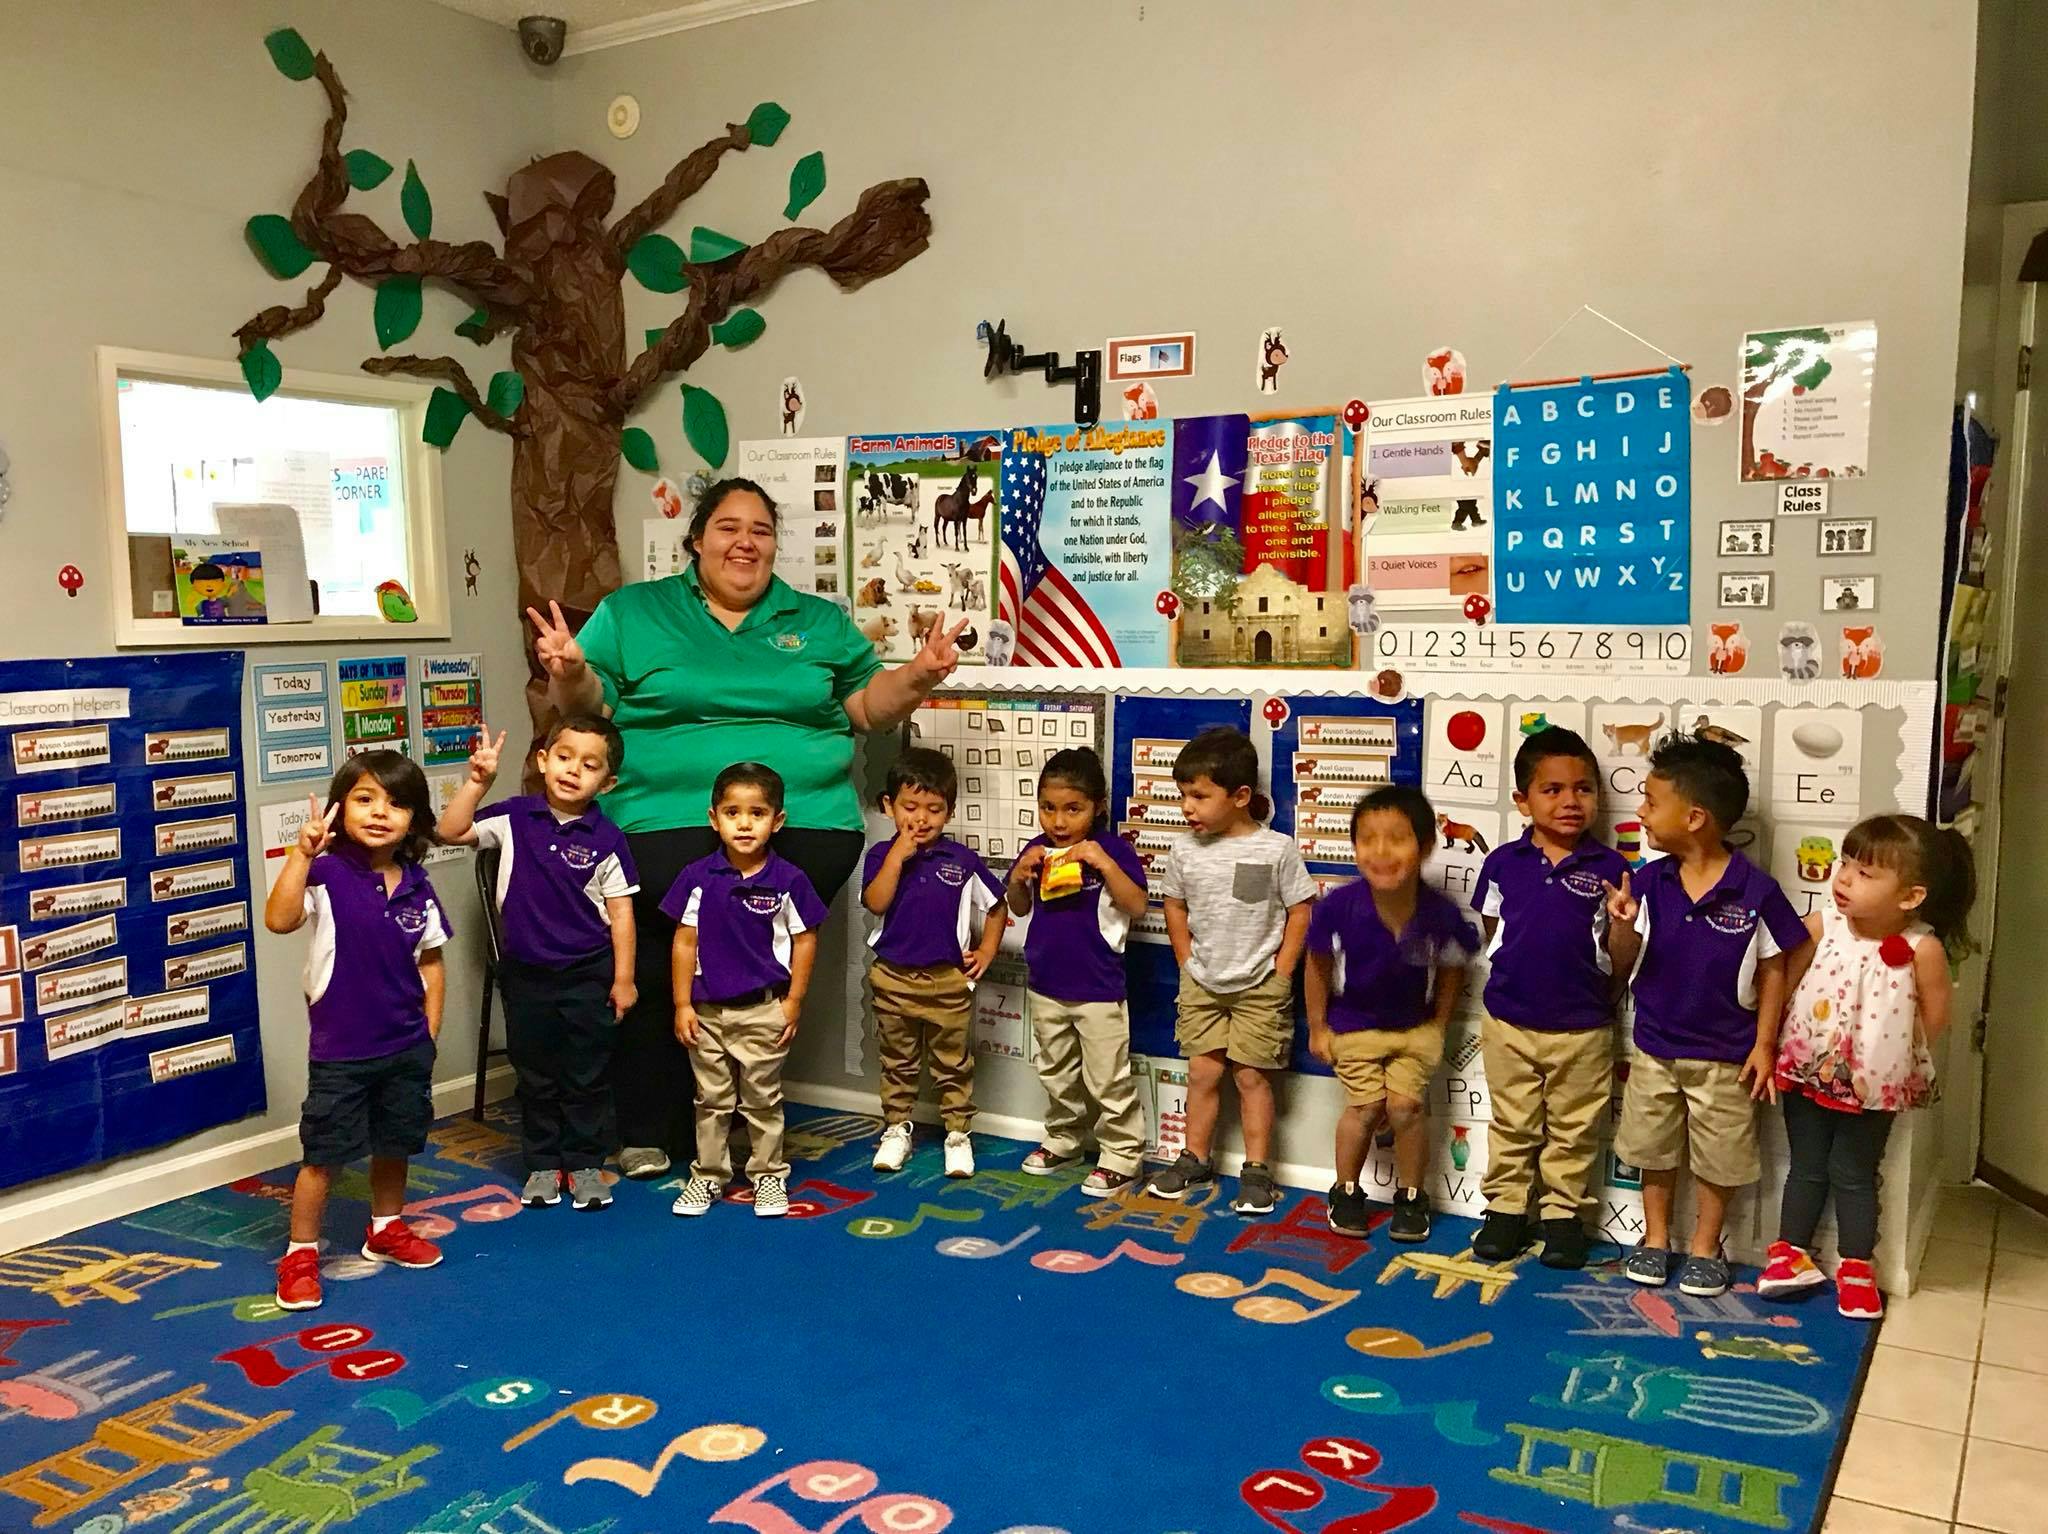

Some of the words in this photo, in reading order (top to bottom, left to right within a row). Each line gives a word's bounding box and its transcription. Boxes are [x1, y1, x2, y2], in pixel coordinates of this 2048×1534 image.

[1120, 353, 1141, 363] Flags
[1503, 405, 1521, 426] A
[1542, 400, 1558, 422] B
[1577, 395, 1594, 417] C
[1616, 392, 1635, 413] D
[1658, 388, 1672, 409] E
[1372, 415, 1393, 428] Our
[1395, 410, 1457, 427] Classroom
[1460, 407, 1491, 422] Rules
[850, 438, 892, 454] Farm
[895, 435, 957, 452] Animals
[1012, 431, 1062, 457] Pledge
[1066, 432, 1081, 452] of
[1085, 427, 1166, 455] Allegiance
[1248, 436, 1290, 452] Pledge
[1293, 435, 1308, 449] to
[1311, 432, 1334, 446] the
[1507, 447, 1520, 467] F
[1541, 443, 1561, 464] G
[1577, 439, 1596, 461] H
[1622, 435, 1629, 456] I
[1658, 432, 1671, 453] J
[747, 450, 765, 462] Our
[767, 449, 811, 461] Classroom
[814, 448, 837, 459] Rules
[1254, 451, 1291, 465] Texas
[1294, 448, 1325, 464] Flag
[1372, 450, 1379, 459] 1.
[1382, 446, 1412, 459] Gentle
[1415, 445, 1444, 457] Hands
[1059, 461, 1084, 474] pledge
[1085, 459, 1123, 474] allegiance
[1124, 459, 1133, 470] to
[1134, 458, 1148, 469] the
[1149, 457, 1164, 471] flag
[1260, 469, 1295, 480] Honor
[1300, 467, 1318, 477] the
[335, 484, 382, 500] CORNER
[1050, 480, 1058, 491] of
[1059, 480, 1071, 491] the
[1072, 478, 1097, 490] United
[1099, 477, 1122, 490] States
[1123, 477, 1132, 488] of
[1132, 476, 1164, 488] America
[1256, 483, 1289, 494] Texas
[1785, 486, 1821, 498] Class
[1506, 489, 1522, 510] K
[1546, 486, 1559, 506] L
[1575, 482, 1599, 503] M
[1616, 478, 1635, 500] N
[1655, 475, 1677, 497] O
[1071, 498, 1085, 509] and
[1087, 498, 1095, 509] to
[1096, 497, 1109, 508] the
[1110, 496, 1143, 509] Republic
[1272, 495, 1312, 508] pledge
[1383, 504, 1419, 517] Walking
[1421, 503, 1441, 514] Feet
[1783, 500, 1821, 512] Rules
[1070, 516, 1081, 527] for
[1083, 516, 1105, 527] which
[1106, 515, 1112, 526] it
[1114, 515, 1141, 528] stands,
[1258, 509, 1320, 522] allegiance
[1246, 524, 1258, 534] to
[1508, 530, 1523, 551] P
[1543, 528, 1563, 549] Q
[1580, 525, 1596, 546] R
[1619, 522, 1635, 543] S
[1660, 520, 1675, 540] T
[222, 539, 249, 547] School
[1064, 536, 1078, 546] one
[1080, 533, 1105, 546] Nation
[1106, 533, 1128, 545] under
[1265, 537, 1287, 546] one
[1291, 535, 1314, 545] and
[1063, 552, 1103, 565] indivisible,
[1105, 552, 1121, 563] with
[1123, 551, 1148, 565] liberty
[1258, 549, 1321, 560] indivisible.
[1370, 561, 1378, 570] 3.
[1381, 559, 1406, 571] Quiet
[1408, 558, 1437, 569] Voices
[1072, 570, 1086, 582] and
[1088, 570, 1113, 584] justice
[1114, 570, 1124, 581] for
[1126, 570, 1139, 581] all.
[1507, 572, 1525, 591] U
[1544, 569, 1561, 589] V
[1574, 566, 1600, 588] W
[1617, 564, 1637, 586] X
[1651, 556, 1665, 574] Y
[1668, 572, 1683, 591] Z
[1425, 631, 1439, 657] 2
[1450, 631, 1466, 657] 3
[1479, 631, 1496, 657] 4
[1510, 631, 1526, 657] 5
[1537, 632, 1555, 658] 6
[1568, 632, 1583, 659] 7
[1596, 632, 1614, 659] 8
[1627, 632, 1643, 659] 9
[1658, 632, 1687, 660] 10
[429, 659, 470, 676] Wednesday
[274, 676, 311, 691] Today
[360, 684, 388, 704] Sunday
[435, 684, 467, 702] Thursday
[0, 700, 70, 717] Classroom
[73, 697, 121, 714] Helpers
[268, 709, 321, 724] Yesterday
[361, 714, 392, 734] Monday
[274, 750, 322, 764] Tomorrow
[1443, 760, 1483, 788] Aa
[1796, 774, 1835, 803] Ee
[279, 812, 310, 829] Today's
[1444, 864, 1475, 893] Ff
[997, 995, 1006, 1009] 7
[1447, 1078, 1482, 1116] Pp
[1444, 1174, 1474, 1203] Vv
[1605, 1201, 1644, 1233] Xx
[861, 1220, 894, 1235] D
[948, 1238, 987, 1256] E
[1046, 1251, 1086, 1270] F
[485, 1381, 531, 1403] S
[592, 1397, 645, 1426] R
